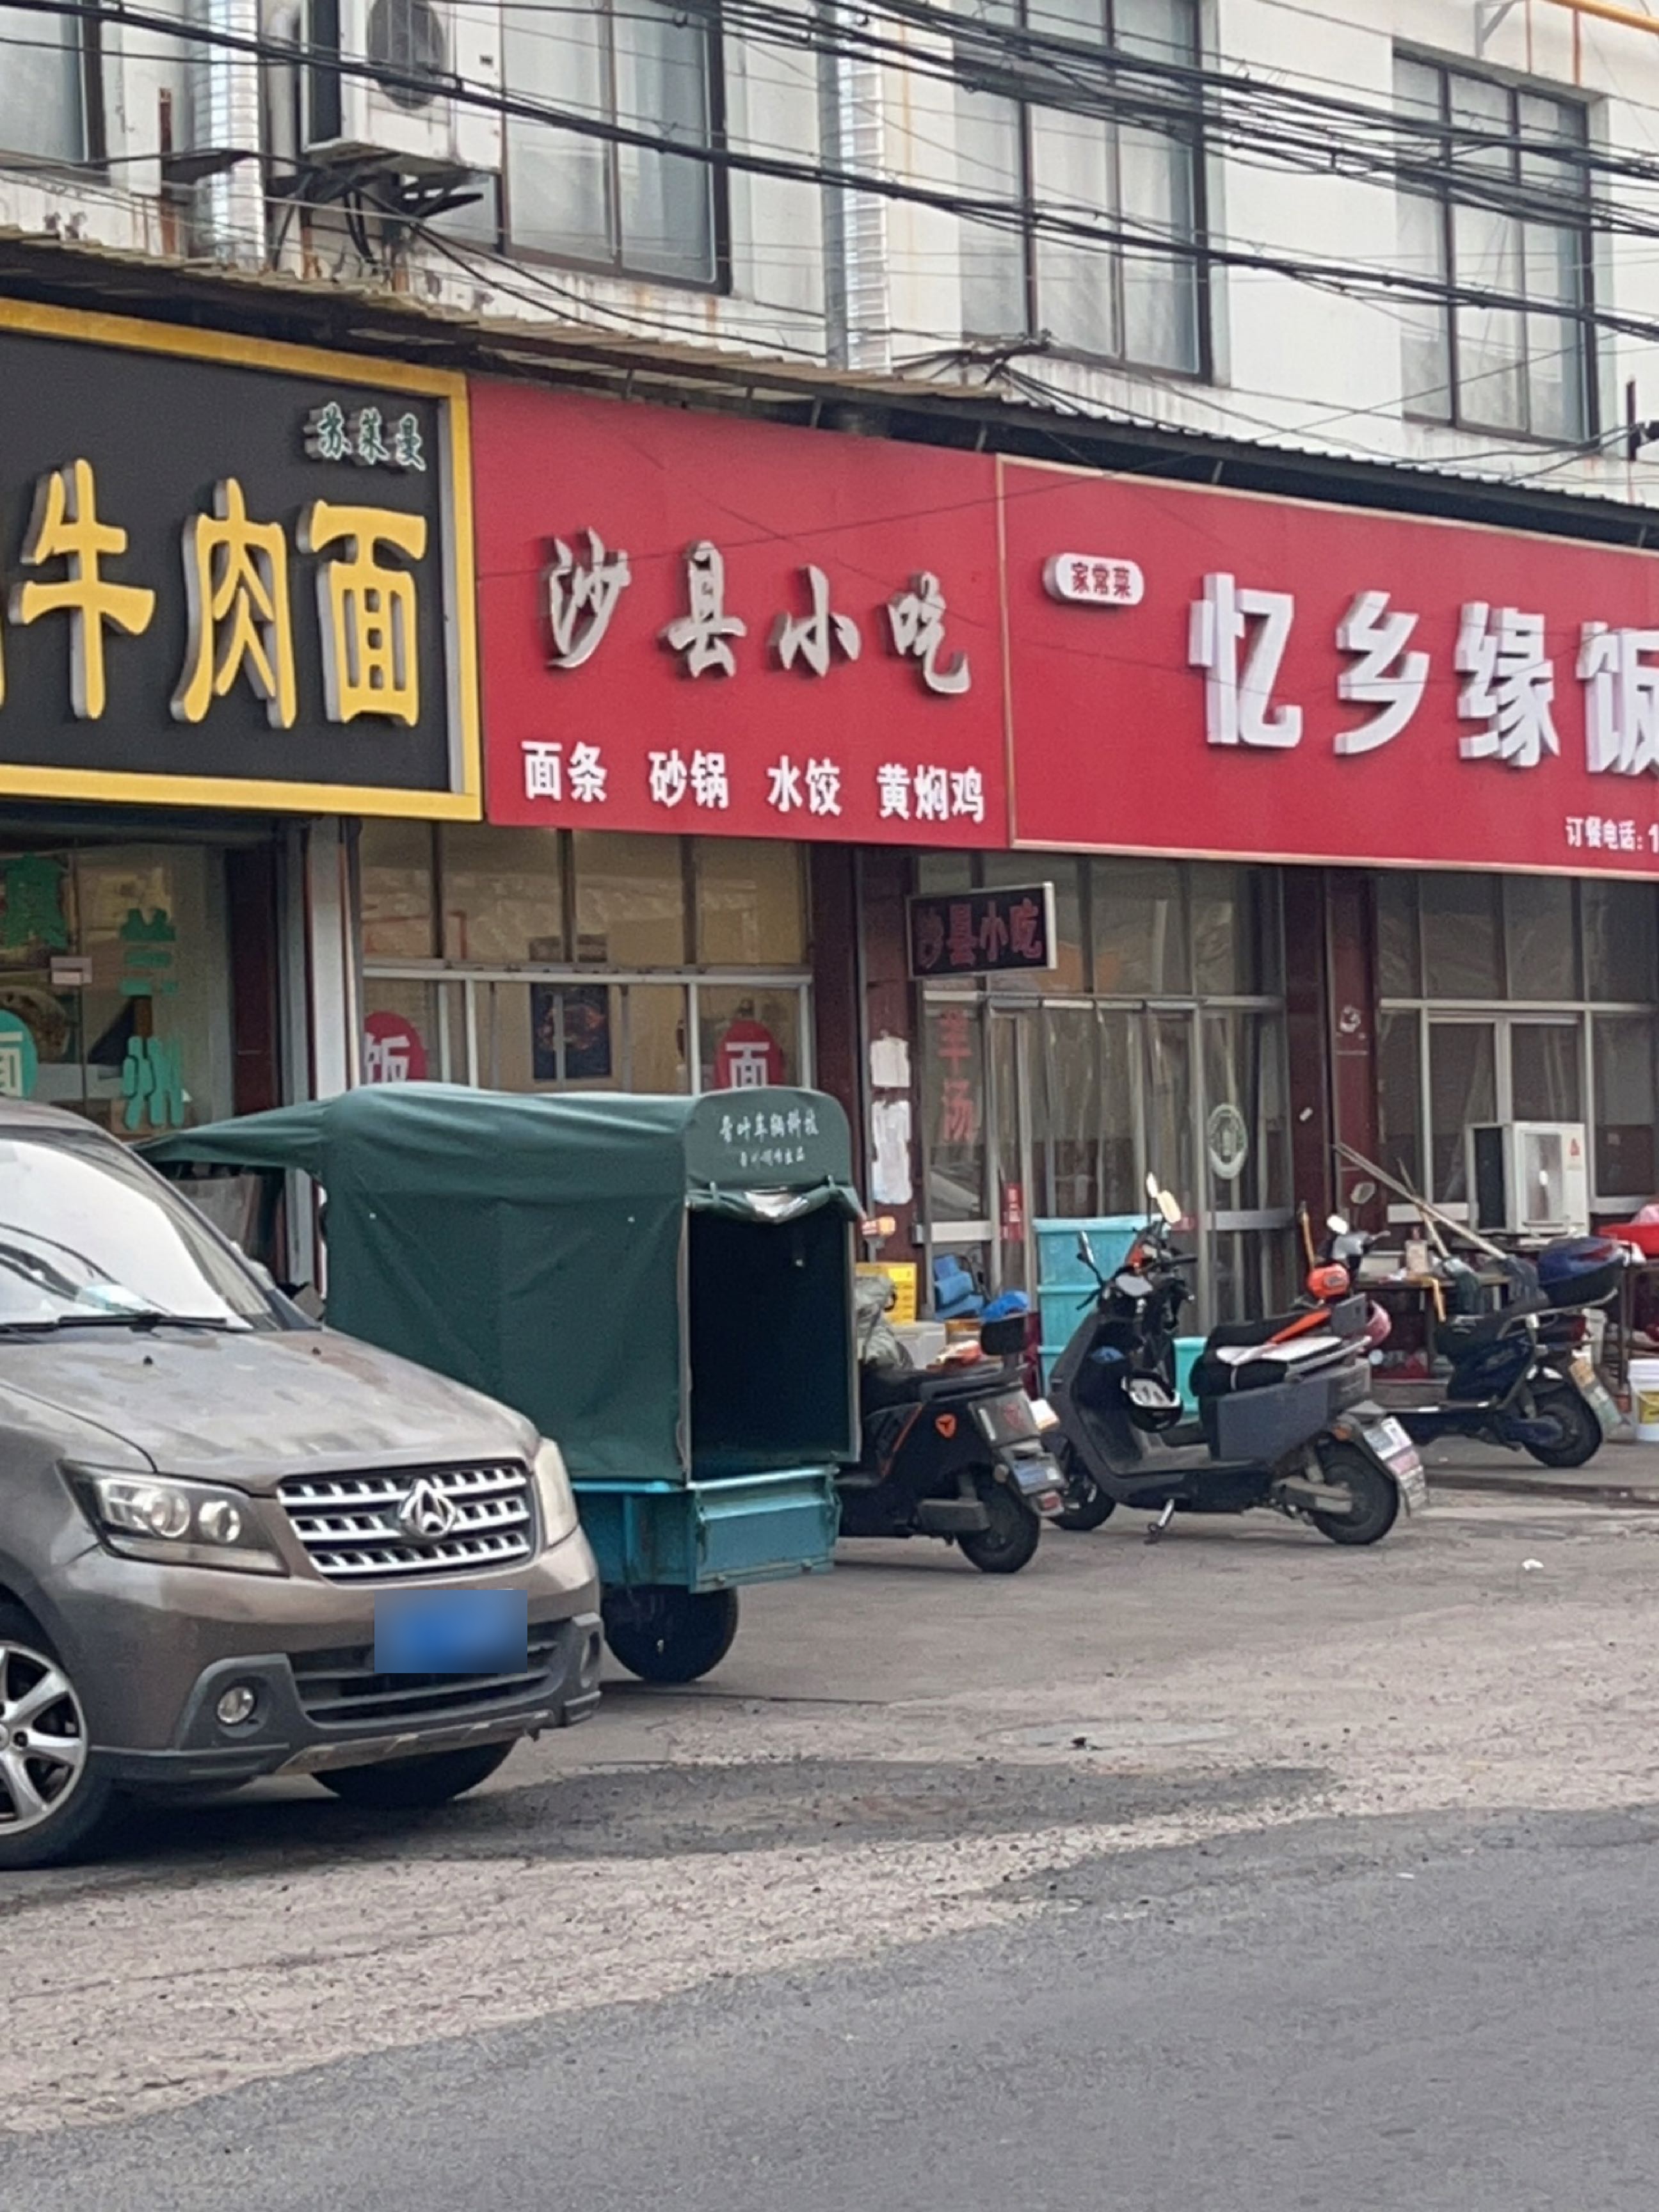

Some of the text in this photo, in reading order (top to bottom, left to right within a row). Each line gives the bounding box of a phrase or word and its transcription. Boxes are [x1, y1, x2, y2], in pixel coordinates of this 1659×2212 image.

[10, 458, 427, 728] 牛肉面
[541, 526, 972, 696] 沙县小吃
[1071, 562, 1131, 599] 家常菜
[1189, 572, 1659, 776] 忆乡缘饭
[521, 741, 985, 824] 面条 砂锅 水饺 黄焖鸡
